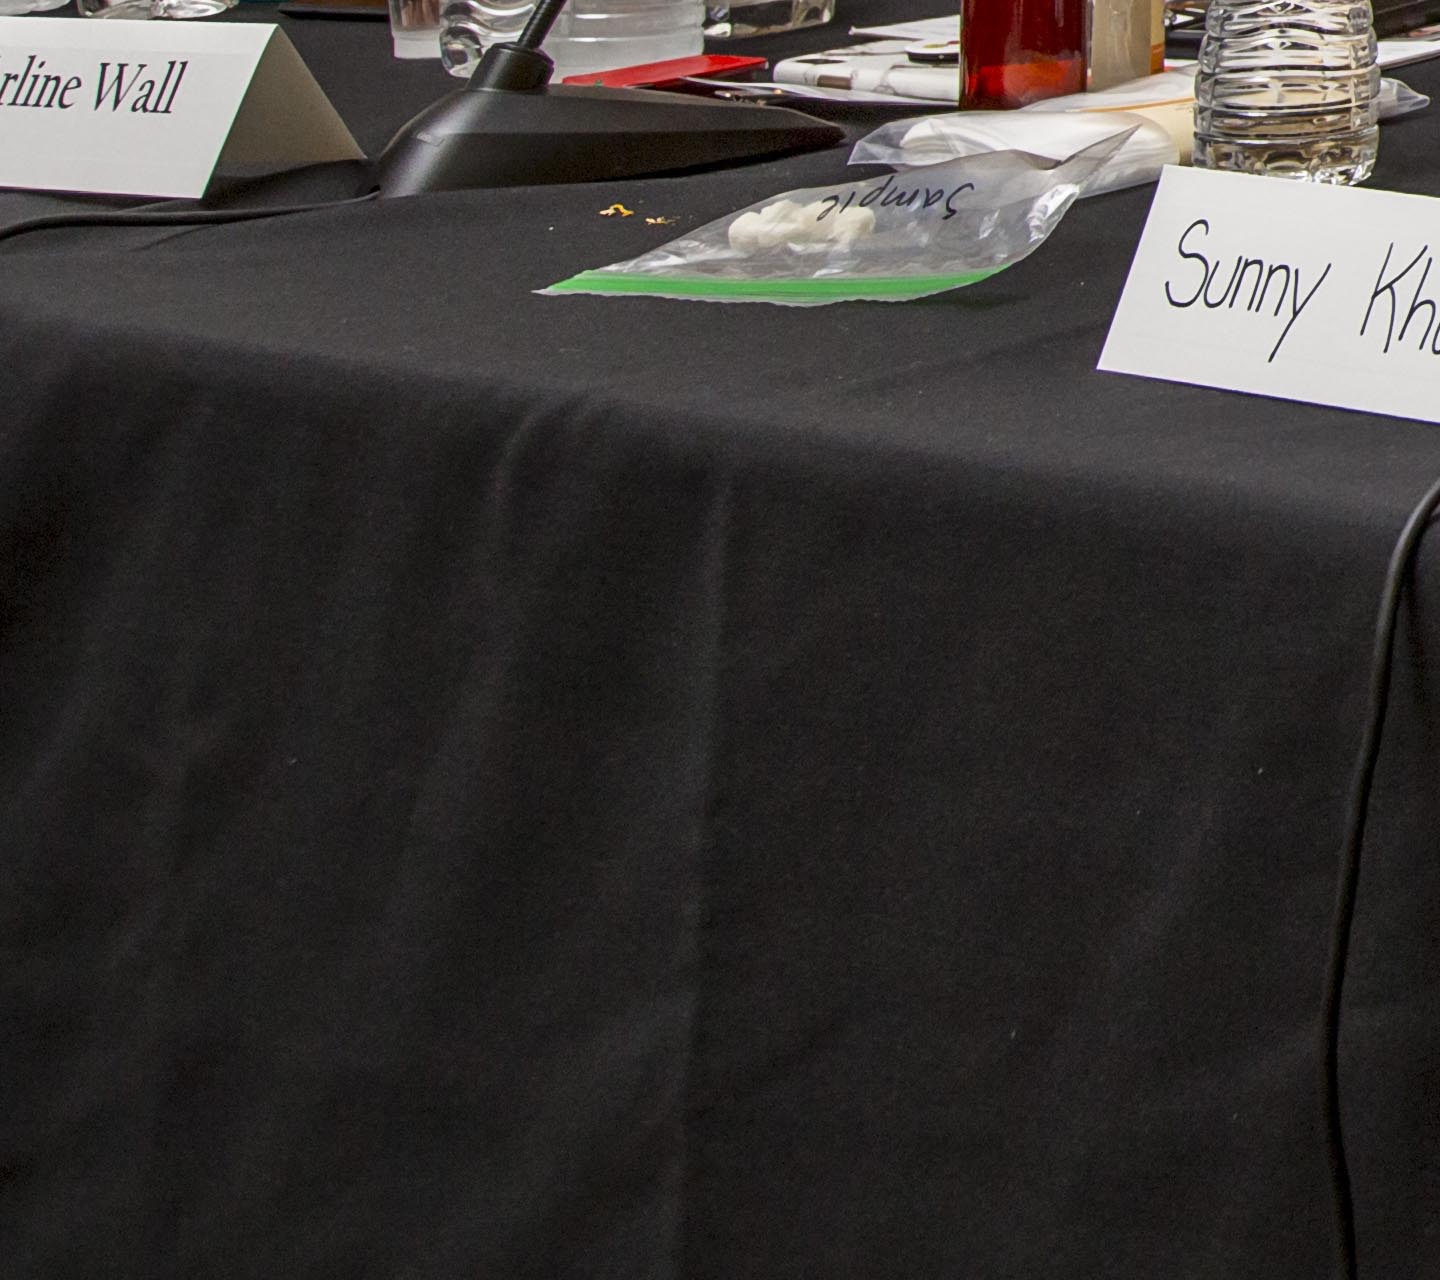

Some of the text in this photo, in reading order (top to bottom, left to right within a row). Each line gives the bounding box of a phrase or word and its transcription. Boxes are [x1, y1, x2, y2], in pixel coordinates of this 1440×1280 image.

[0, 55, 189, 114] rline Wall
[816, 175, 975, 221] Sample
[1165, 219, 1332, 363] Sunny
